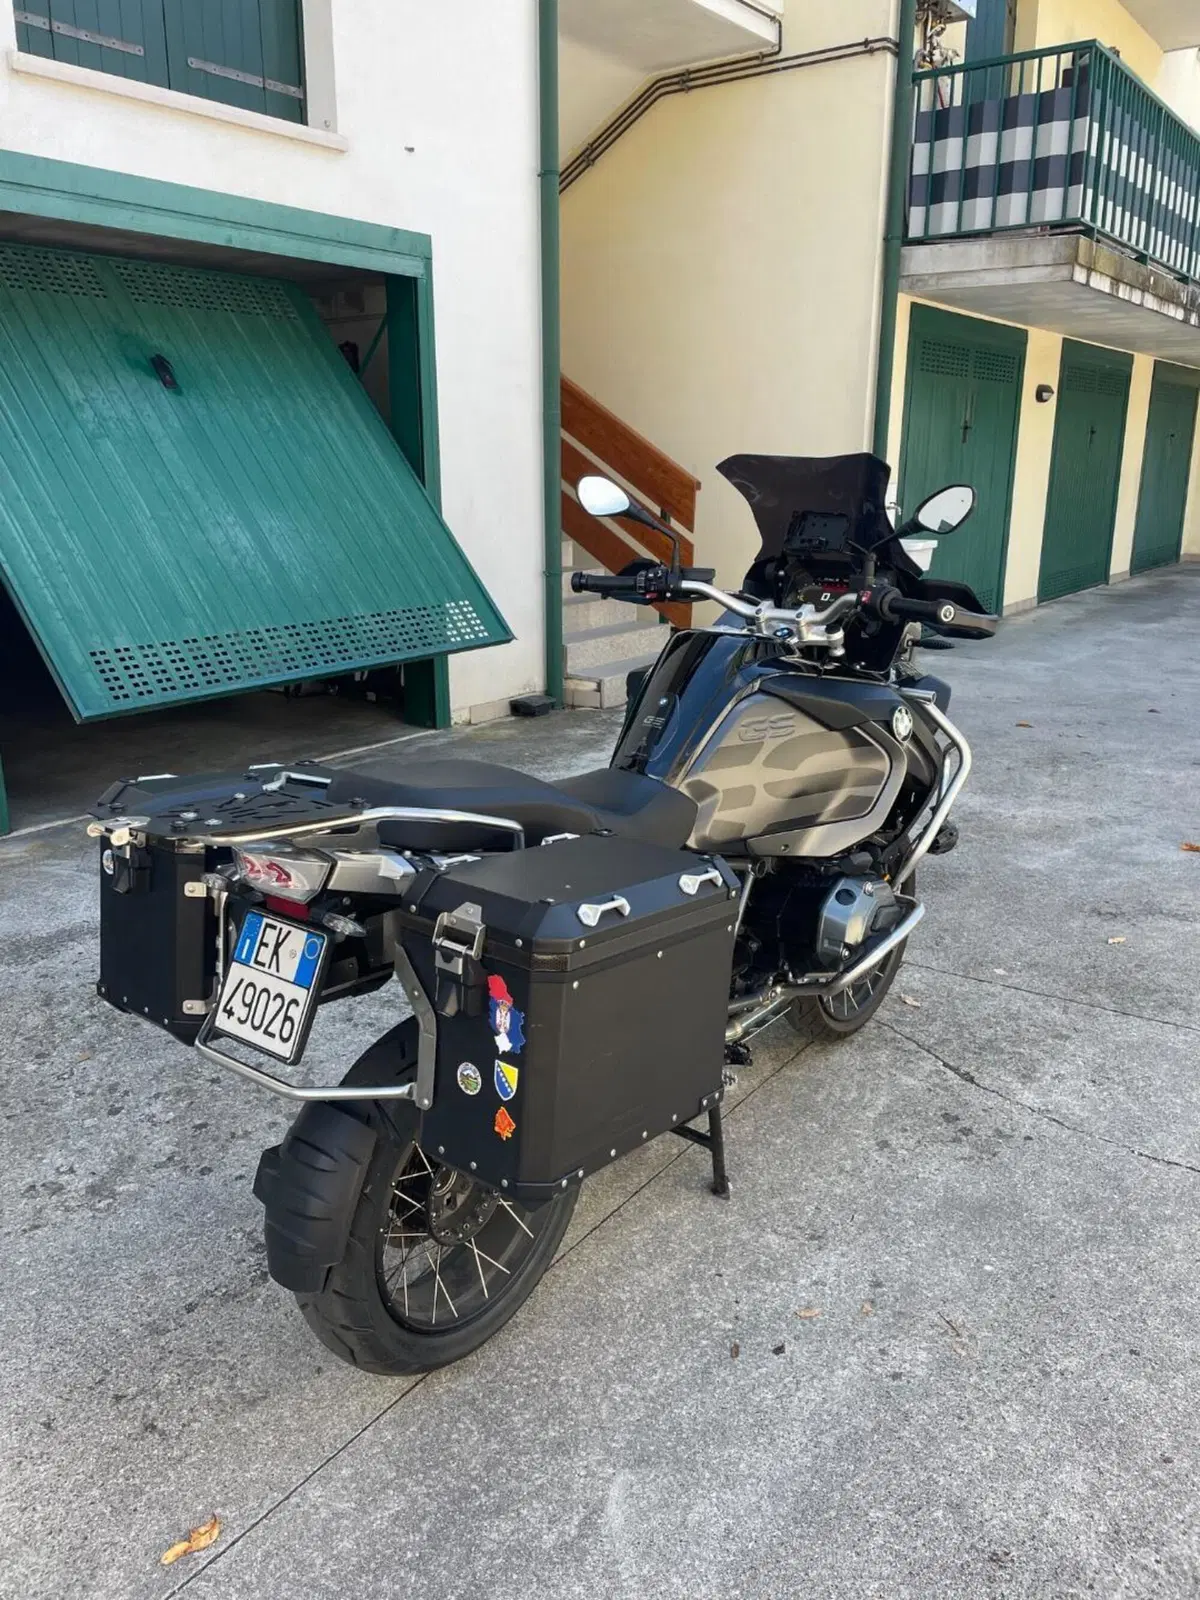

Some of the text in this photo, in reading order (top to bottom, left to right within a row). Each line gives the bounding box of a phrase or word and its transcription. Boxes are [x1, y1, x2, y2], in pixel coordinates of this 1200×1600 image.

[738, 713, 797, 742] GS
[253, 922, 291, 973] EK
[222, 978, 300, 1043] 49026
